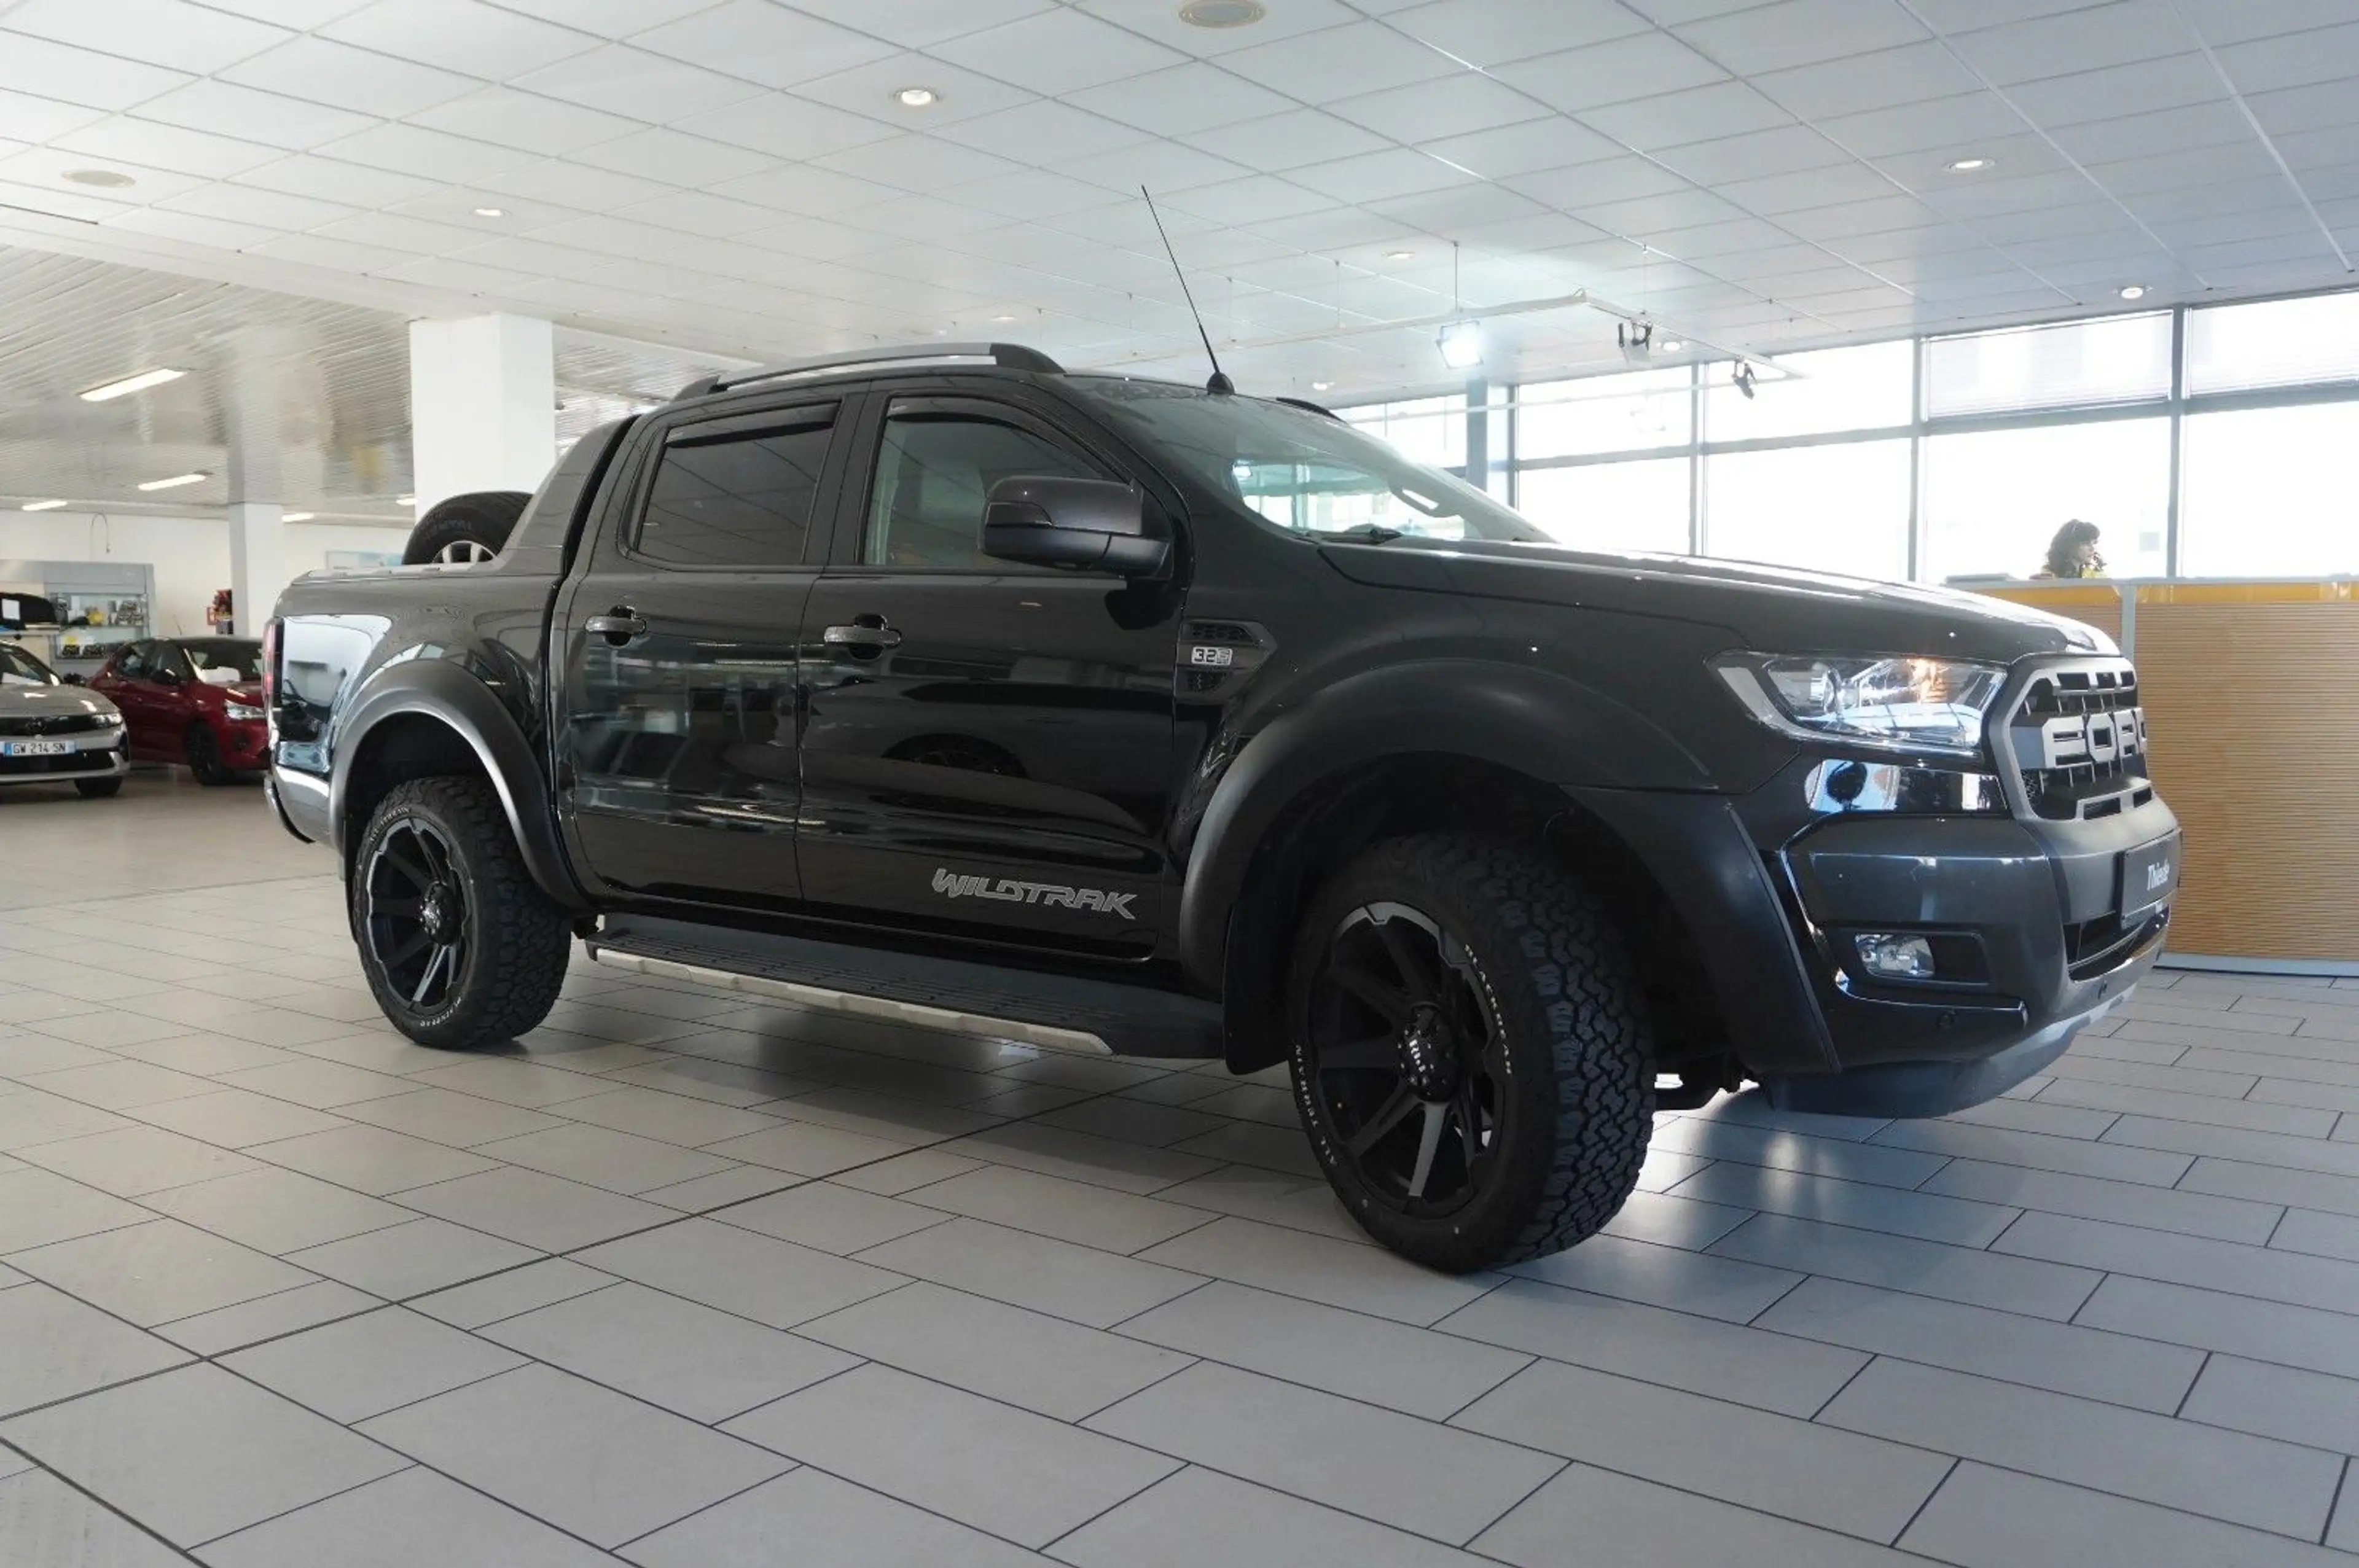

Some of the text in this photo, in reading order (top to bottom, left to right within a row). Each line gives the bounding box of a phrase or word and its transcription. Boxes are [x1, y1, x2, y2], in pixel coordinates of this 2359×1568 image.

[31, 742, 49, 753] 214
[932, 868, 1138, 920] WILDTRAK
[1295, 1044, 1319, 1129] TERRAIN
